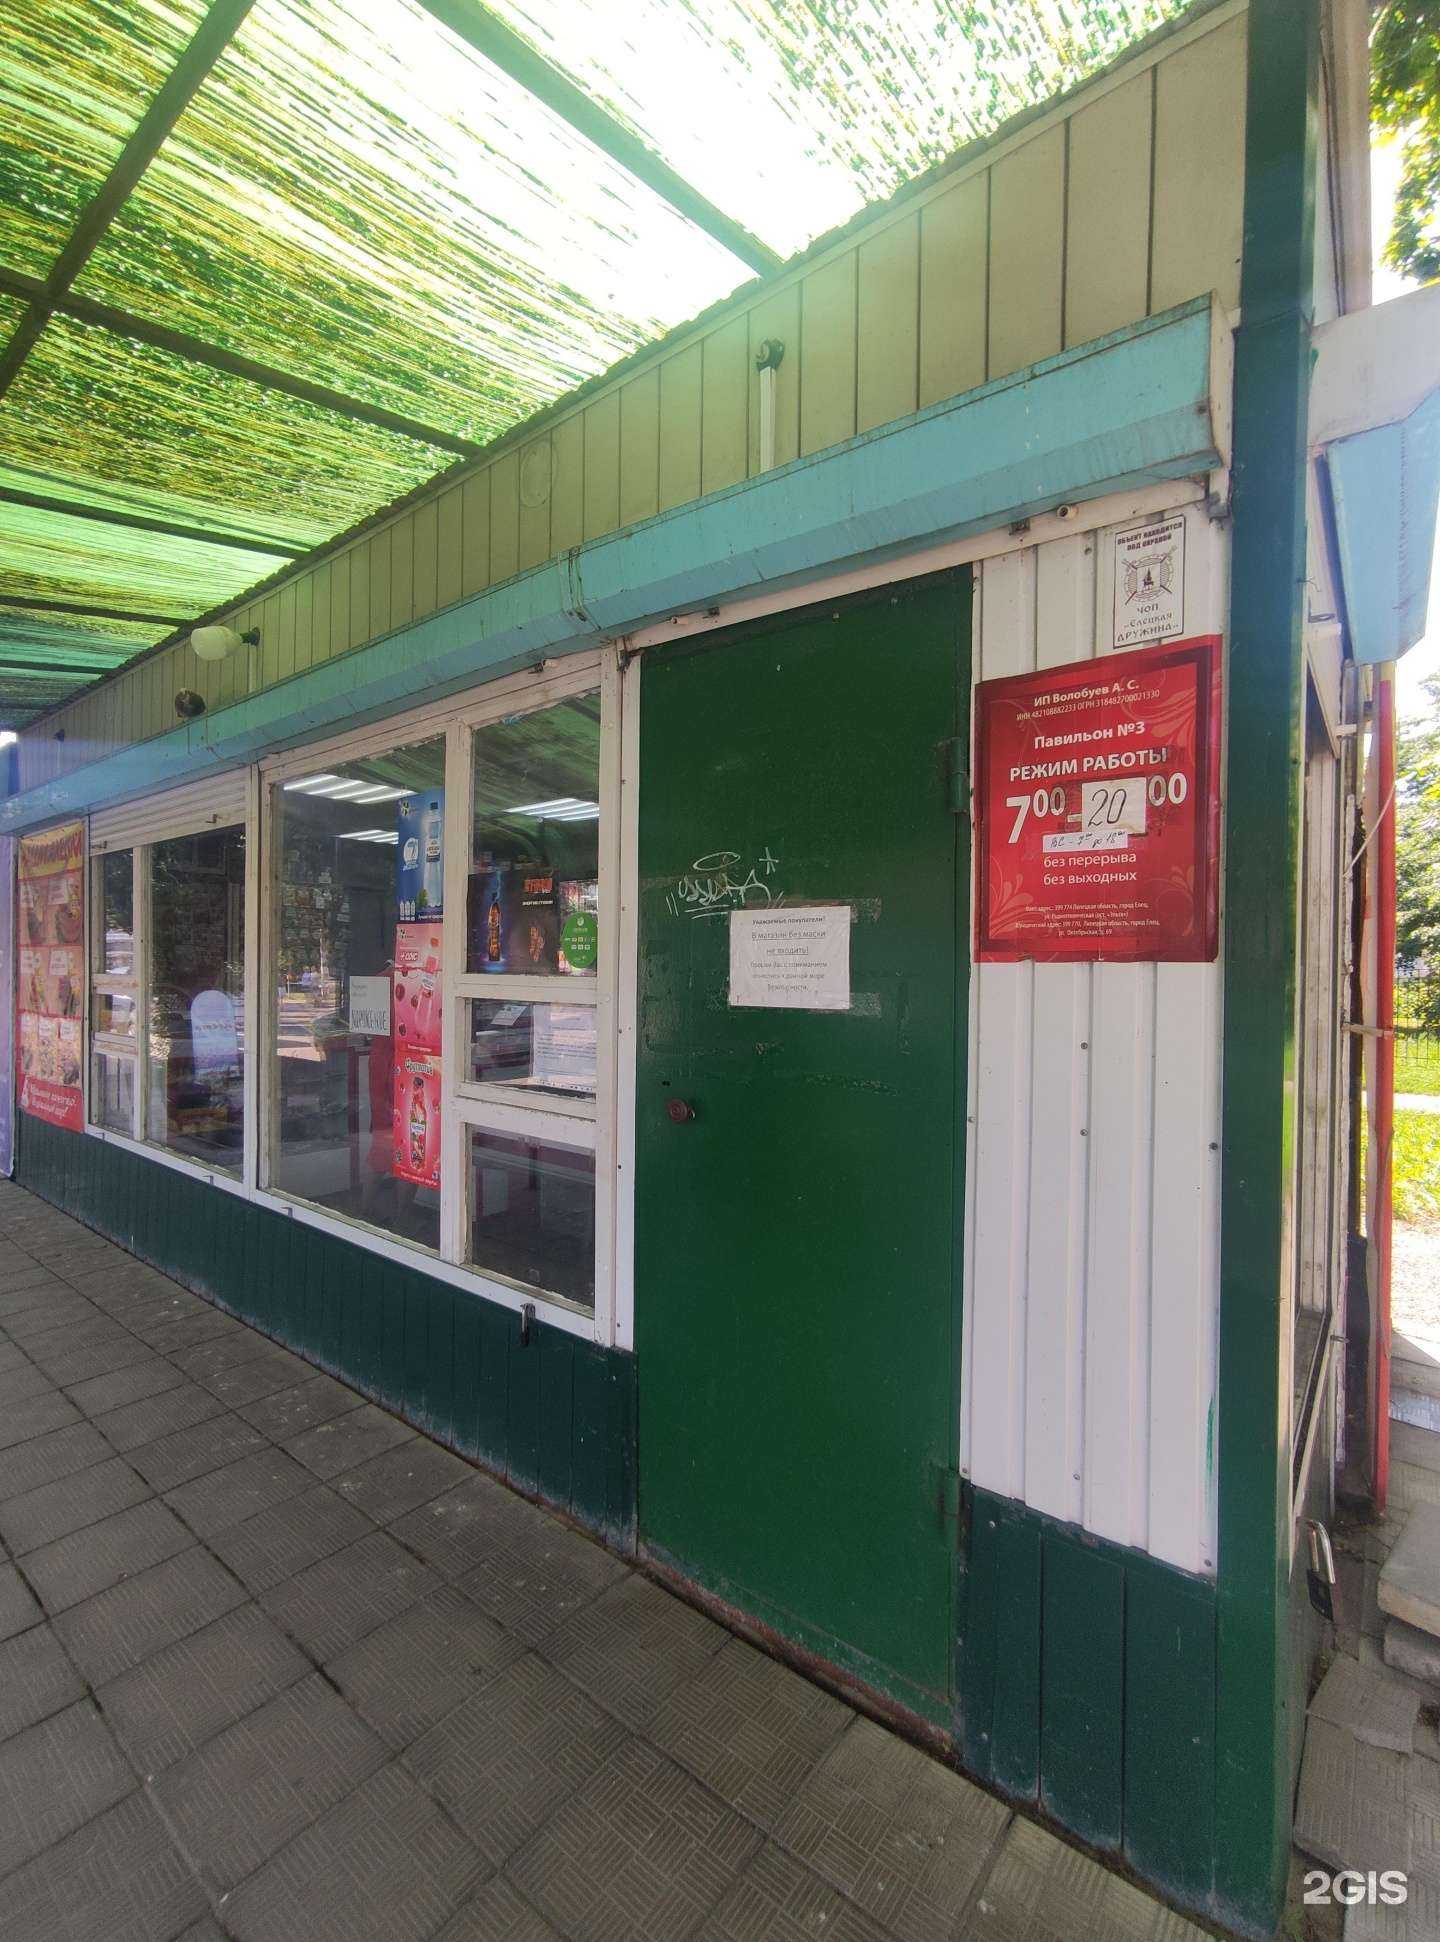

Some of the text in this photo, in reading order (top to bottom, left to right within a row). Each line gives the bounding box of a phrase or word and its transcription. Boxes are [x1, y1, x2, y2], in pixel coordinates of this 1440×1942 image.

[1137, 603, 1159, 614] ЧОП
[1033, 679, 1140, 708] ИП Волобуев А. С.
[1016, 711, 1031, 721] ИНН
[1077, 700, 1095, 711] ОГРН
[1034, 721, 1146, 749] Павильон №3
[1010, 747, 1168, 782] РЕЖИМ РАБОТЫ
[1148, 772, 1188, 807] 00
[1087, 788, 1127, 828] 20
[1043, 853, 1137, 869] без перерыва
[1043, 871, 1137, 886] без выходных
